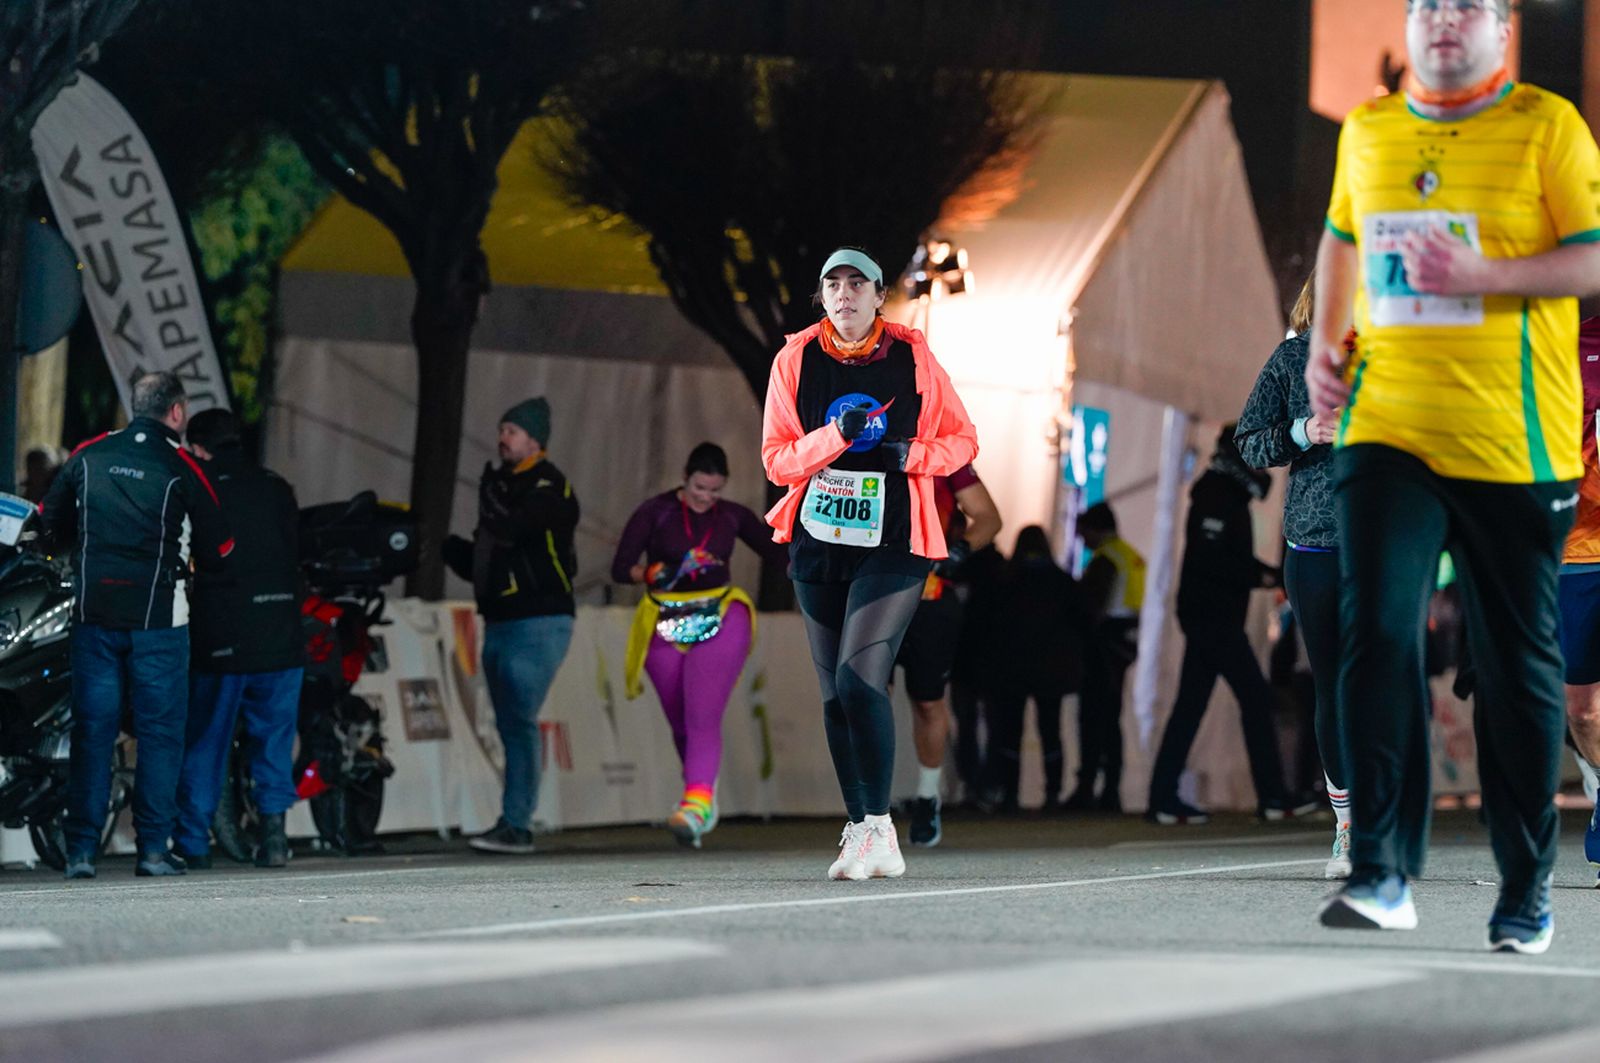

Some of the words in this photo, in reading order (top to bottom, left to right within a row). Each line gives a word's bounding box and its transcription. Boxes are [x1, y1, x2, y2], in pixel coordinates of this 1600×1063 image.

[845, 480, 855, 488] DE
[828, 486, 855, 497] ANTÓN
[815, 492, 872, 522] 12108
